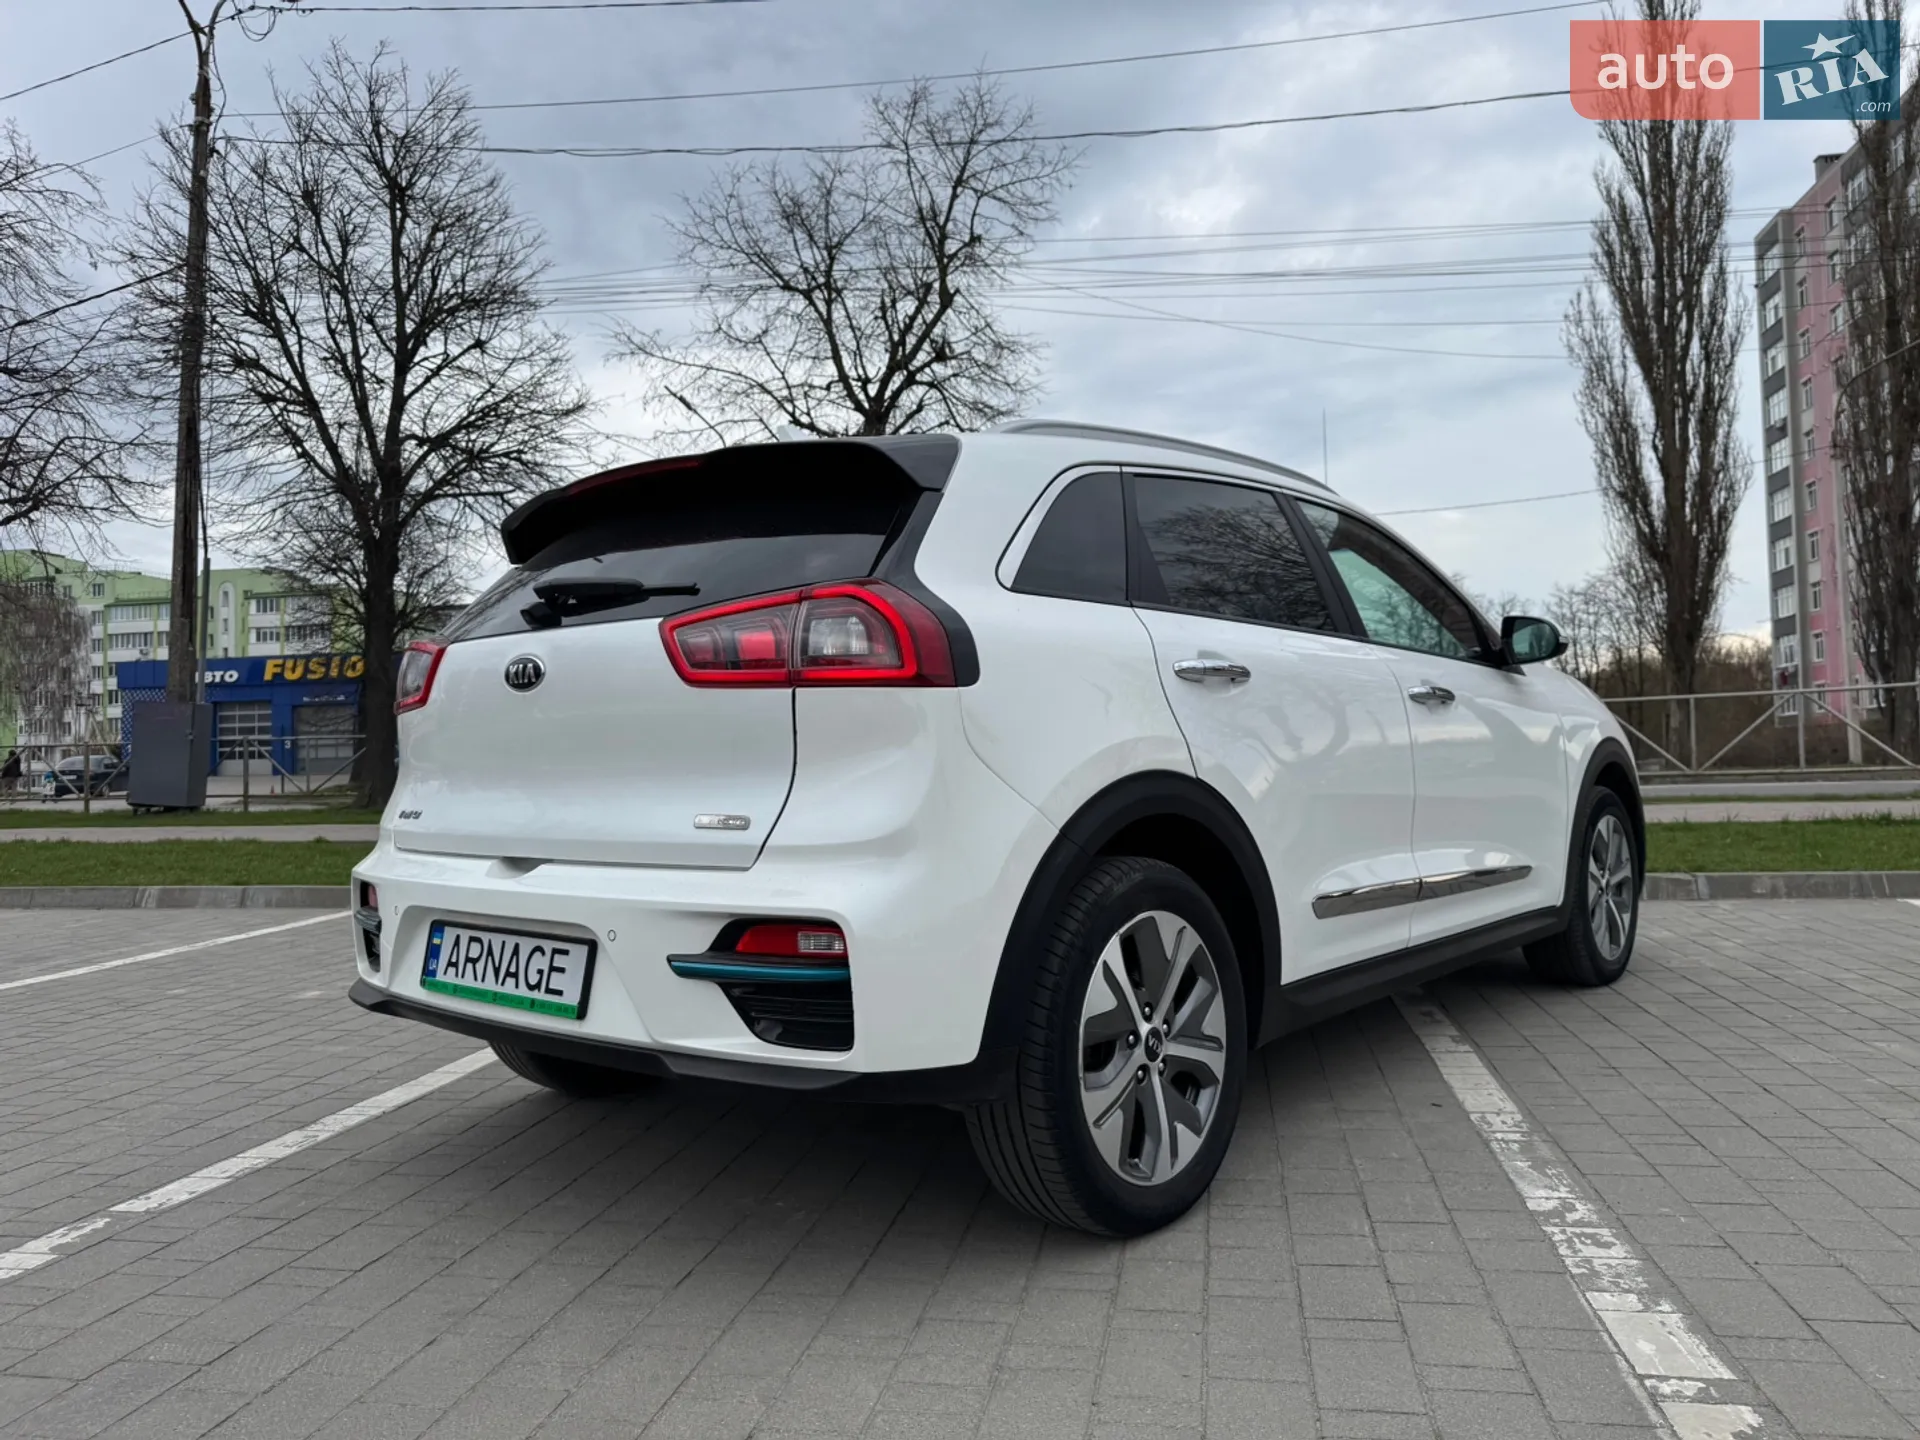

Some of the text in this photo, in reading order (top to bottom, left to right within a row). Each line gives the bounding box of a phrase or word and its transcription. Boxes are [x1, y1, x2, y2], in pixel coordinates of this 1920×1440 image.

[509, 662, 536, 684] KIA
[284, 740, 291, 749] 3
[443, 933, 570, 997] ARNAGE
